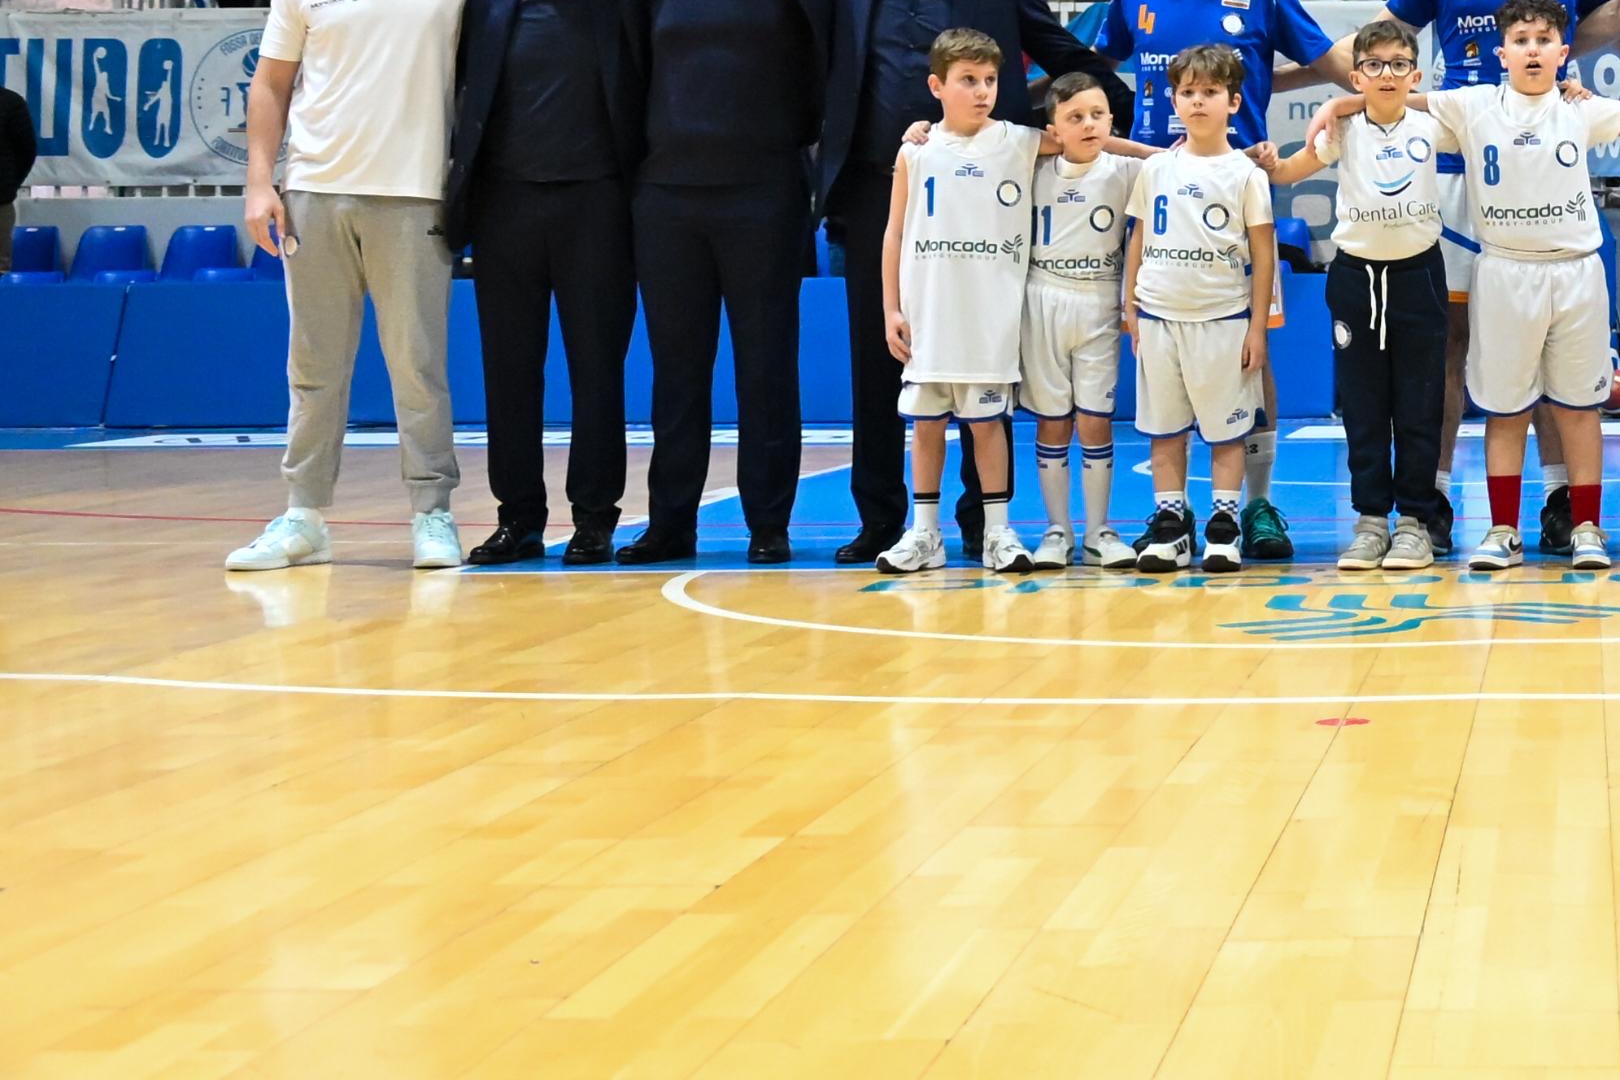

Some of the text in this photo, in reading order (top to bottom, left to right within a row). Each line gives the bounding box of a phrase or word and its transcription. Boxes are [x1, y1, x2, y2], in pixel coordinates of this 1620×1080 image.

[1138, 4, 1156, 34] 4
[1483, 144, 1500, 186] 8
[924, 176, 935, 217] 1
[1349, 201, 1403, 223] Dental
[1406, 200, 1437, 217] Care
[1153, 194, 1169, 235] 6
[915, 240, 998, 254] Moncada
[1143, 245, 1214, 261] Moncada
